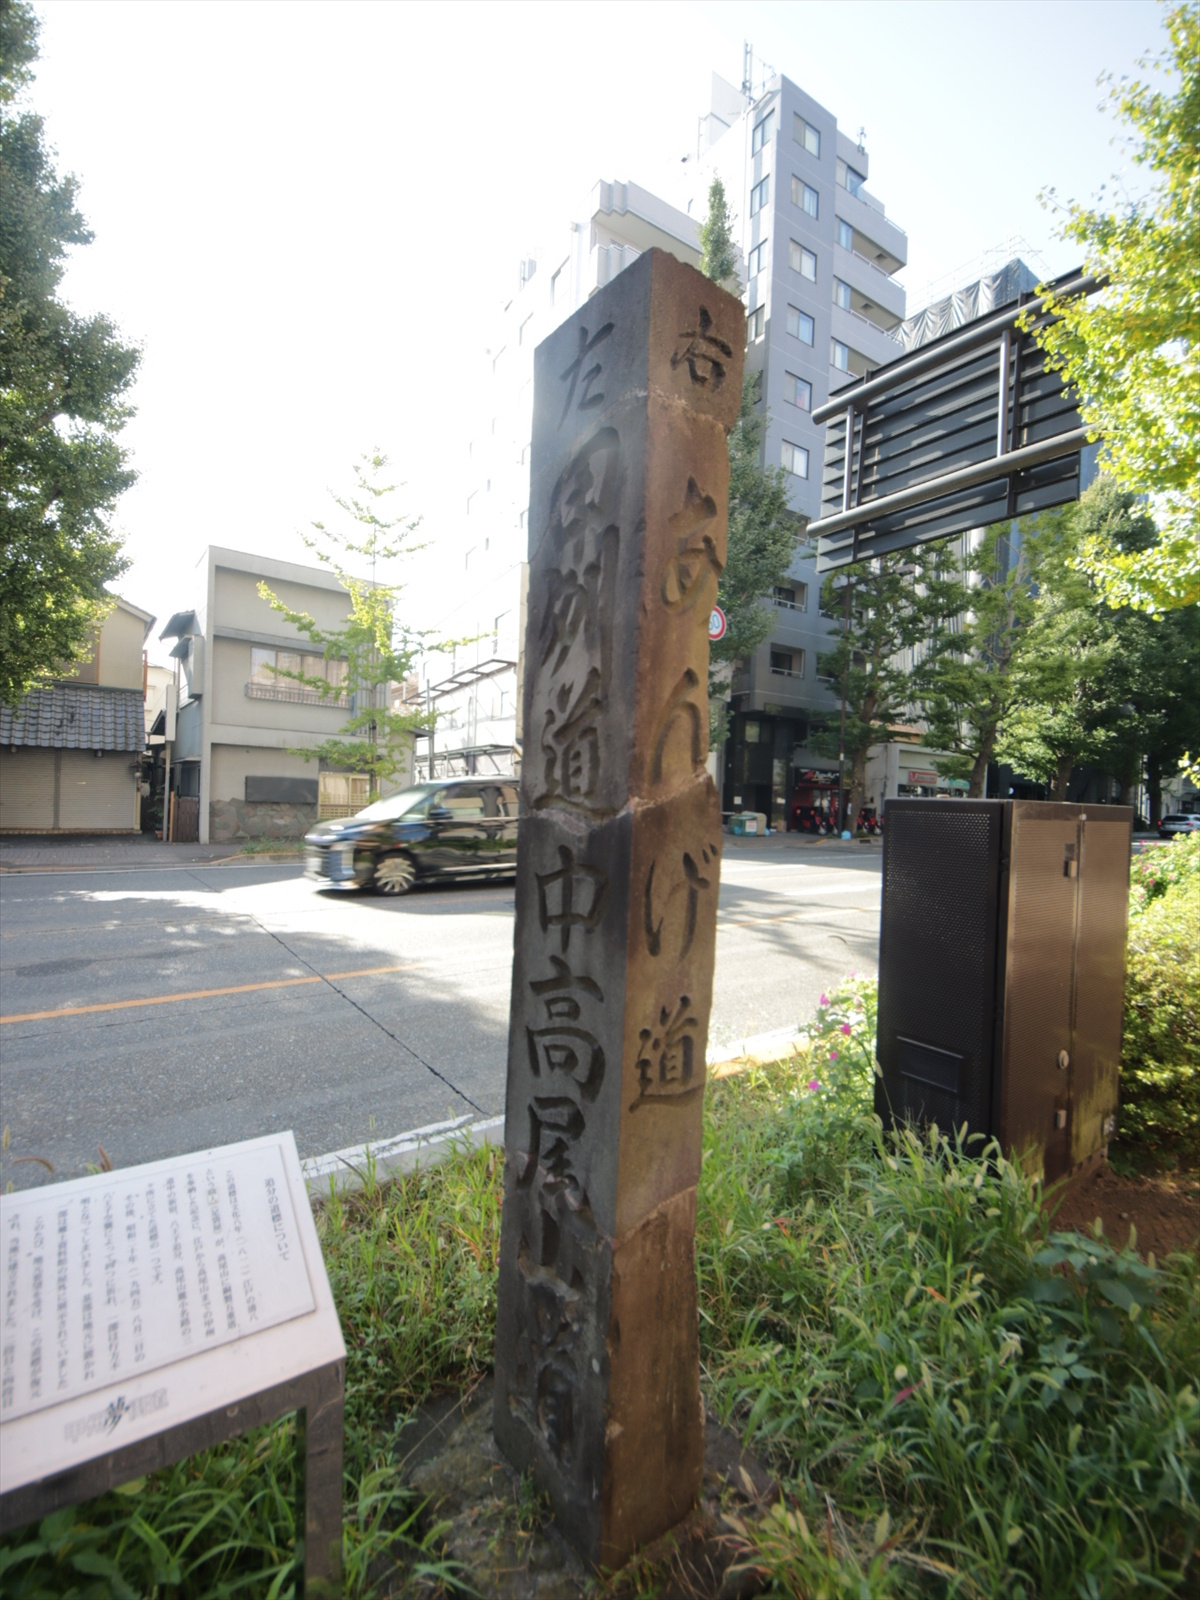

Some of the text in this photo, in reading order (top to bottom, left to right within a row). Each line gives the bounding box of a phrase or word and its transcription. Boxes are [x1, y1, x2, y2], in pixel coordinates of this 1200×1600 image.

[264, 1176, 290, 1262] 追分の道標について
